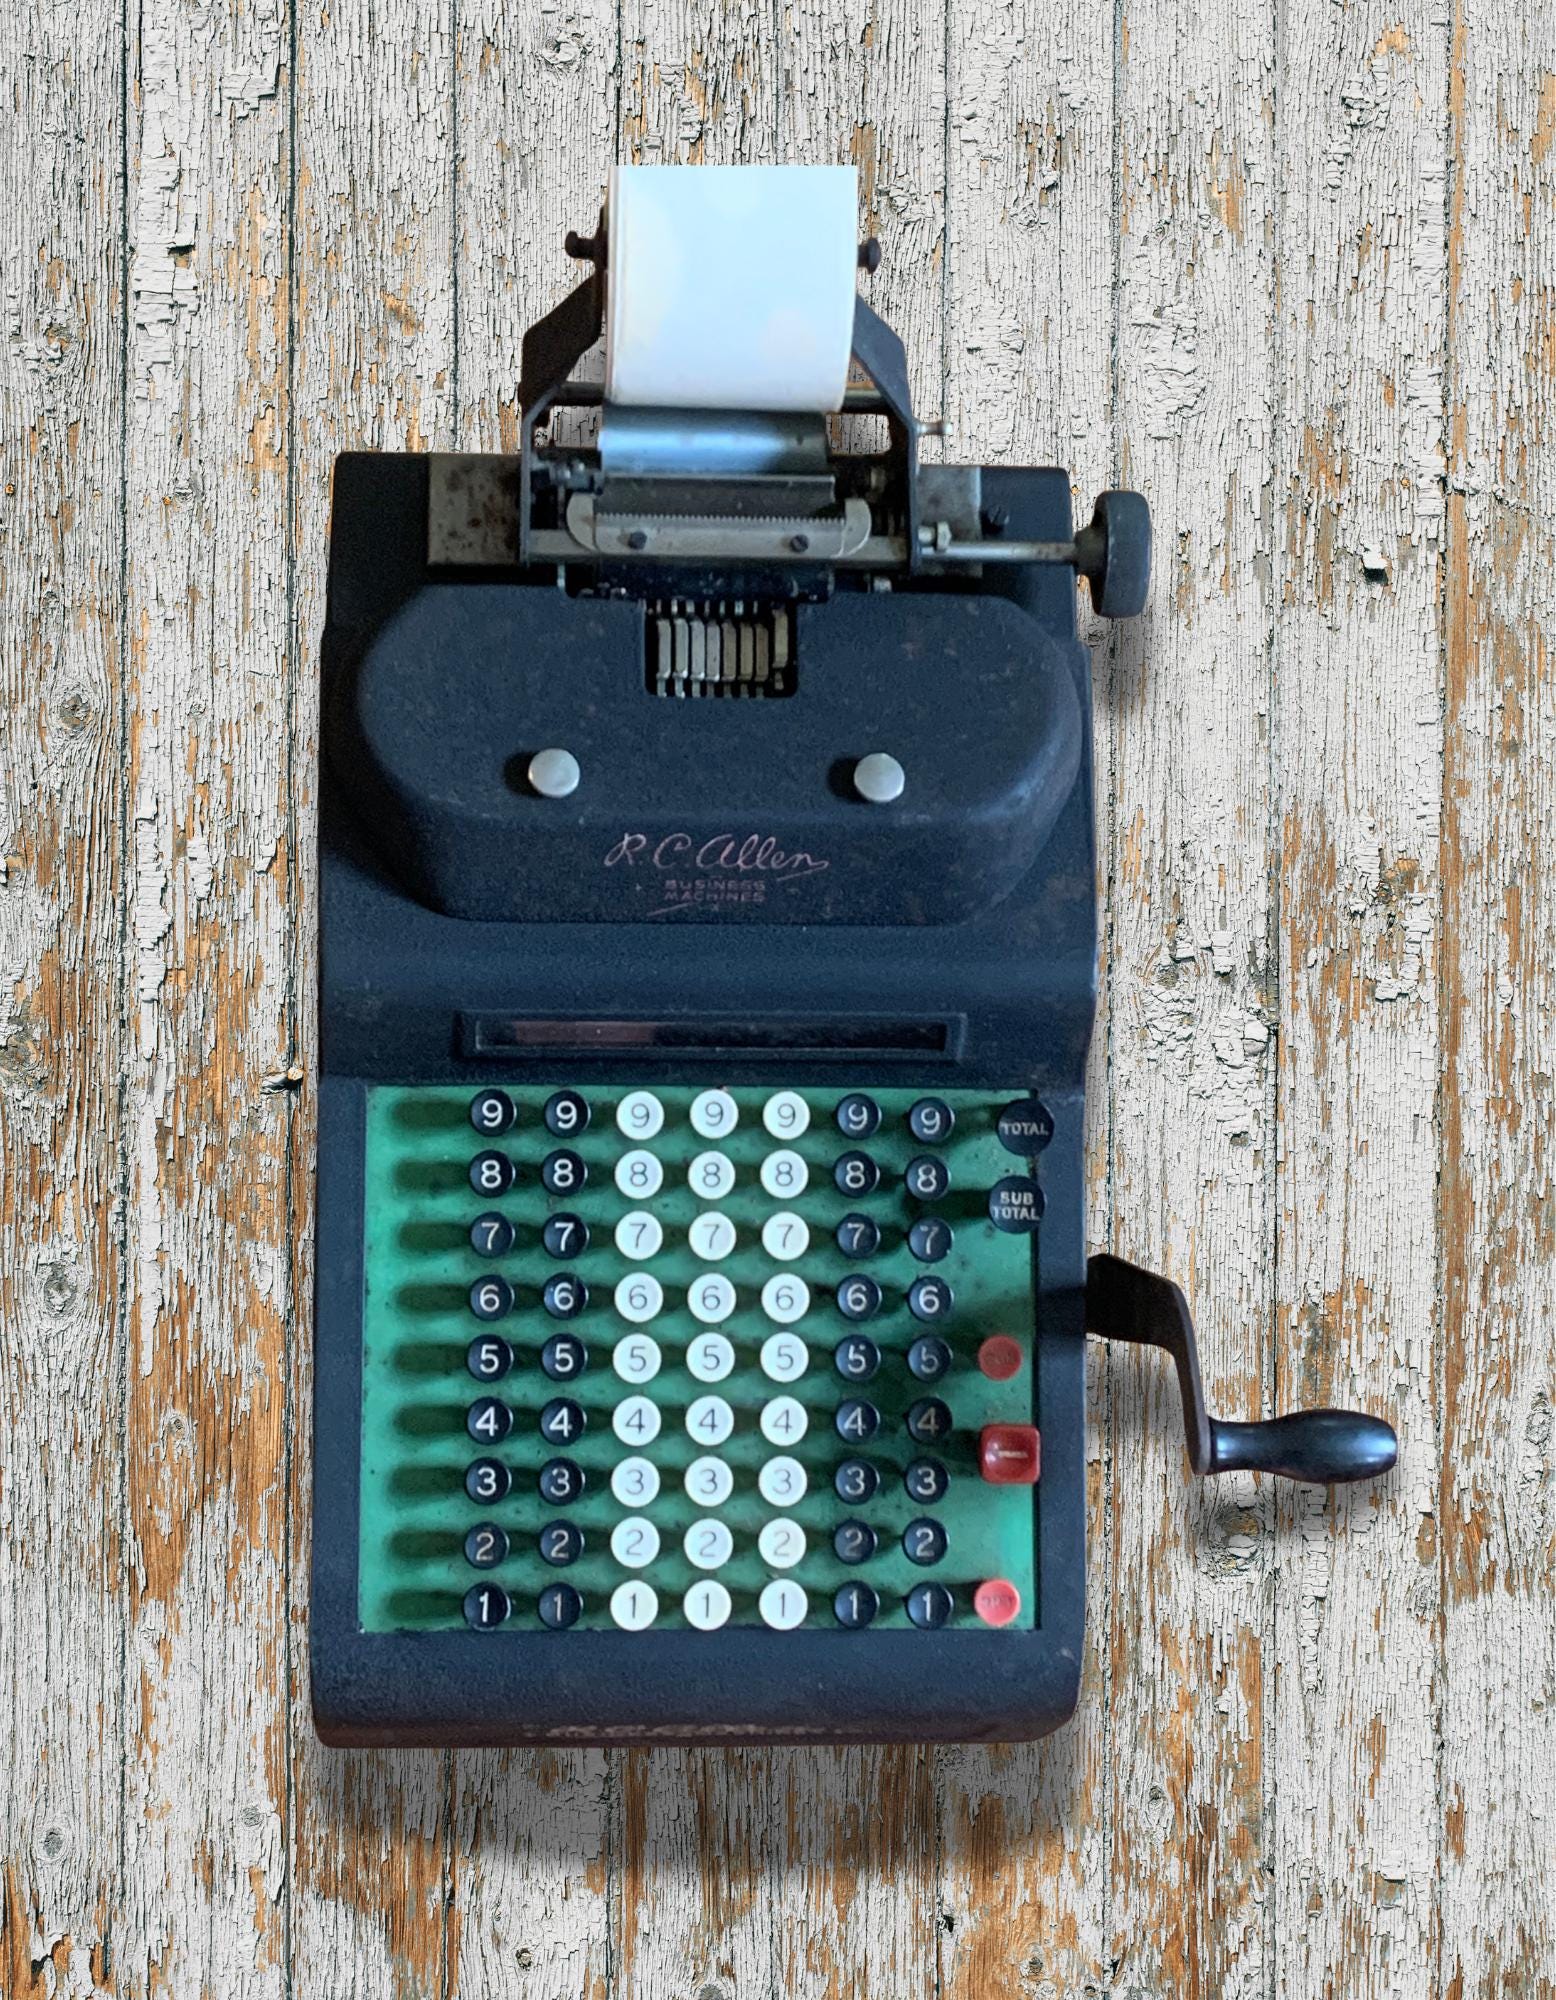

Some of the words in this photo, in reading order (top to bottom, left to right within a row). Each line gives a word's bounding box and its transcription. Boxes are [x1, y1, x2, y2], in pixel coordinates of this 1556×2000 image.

[696, 834, 829, 871] Allen
[664, 879, 767, 890] BUSINESS
[664, 891, 767, 902] MACHINES
[481, 1098, 503, 1128] 9
[555, 1100, 578, 1130] 9
[630, 1102, 651, 1129] 9
[704, 1100, 725, 1127] 9
[777, 1103, 797, 1129] 9
[847, 1103, 869, 1131] 9
[920, 1107, 941, 1135] 9
[1000, 1122, 1050, 1136] TOTAL
[480, 1159, 502, 1189] 8
[552, 1158, 575, 1188] 8
[629, 1161, 649, 1188] 8
[702, 1161, 722, 1189] 8
[774, 1160, 794, 1188] 8
[845, 1160, 866, 1189] 8
[916, 1164, 938, 1193] 8
[993, 1206, 1040, 1220] TOTAL
[999, 1191, 1034, 1204] SUB
[481, 1221, 500, 1251] 7
[554, 1221, 575, 1252] 7
[629, 1222, 648, 1249] 7
[703, 1223, 721, 1250] 7
[776, 1223, 795, 1249] 7
[846, 1222, 866, 1251] 7
[920, 1225, 939, 1255] 7
[479, 1284, 500, 1313] 6
[553, 1281, 575, 1311] 6
[628, 1284, 648, 1311] 6
[701, 1284, 721, 1311] 6
[775, 1285, 795, 1311] 6
[846, 1283, 868, 1312] 6
[918, 1284, 940, 1314] 6
[479, 1343, 500, 1374] 5
[554, 1342, 574, 1373] 5
[629, 1345, 647, 1373] 5
[703, 1344, 721, 1371] 5
[777, 1344, 795, 1371] 5
[847, 1344, 867, 1374] 5
[920, 1345, 940, 1374] 5
[474, 1405, 499, 1437] 4
[548, 1406, 572, 1438] 4
[624, 1407, 646, 1434] 4
[698, 1407, 719, 1434] 4
[772, 1408, 793, 1434] 4
[843, 1406, 867, 1437] 4
[917, 1406, 940, 1436] 4
[476, 1466, 497, 1497] 3
[550, 1468, 571, 1497] 3
[626, 1468, 645, 1496] 3
[700, 1468, 718, 1495] 3
[772, 1468, 793, 1495] 3
[844, 1466, 865, 1495] 3
[916, 1466, 937, 1496] 3
[475, 1531, 495, 1561] 2
[550, 1529, 570, 1559] 2
[625, 1528, 644, 1556] 2
[698, 1530, 718, 1558] 2
[773, 1530, 791, 1558] 2
[844, 1528, 863, 1557] 2
[915, 1527, 934, 1557] 2
